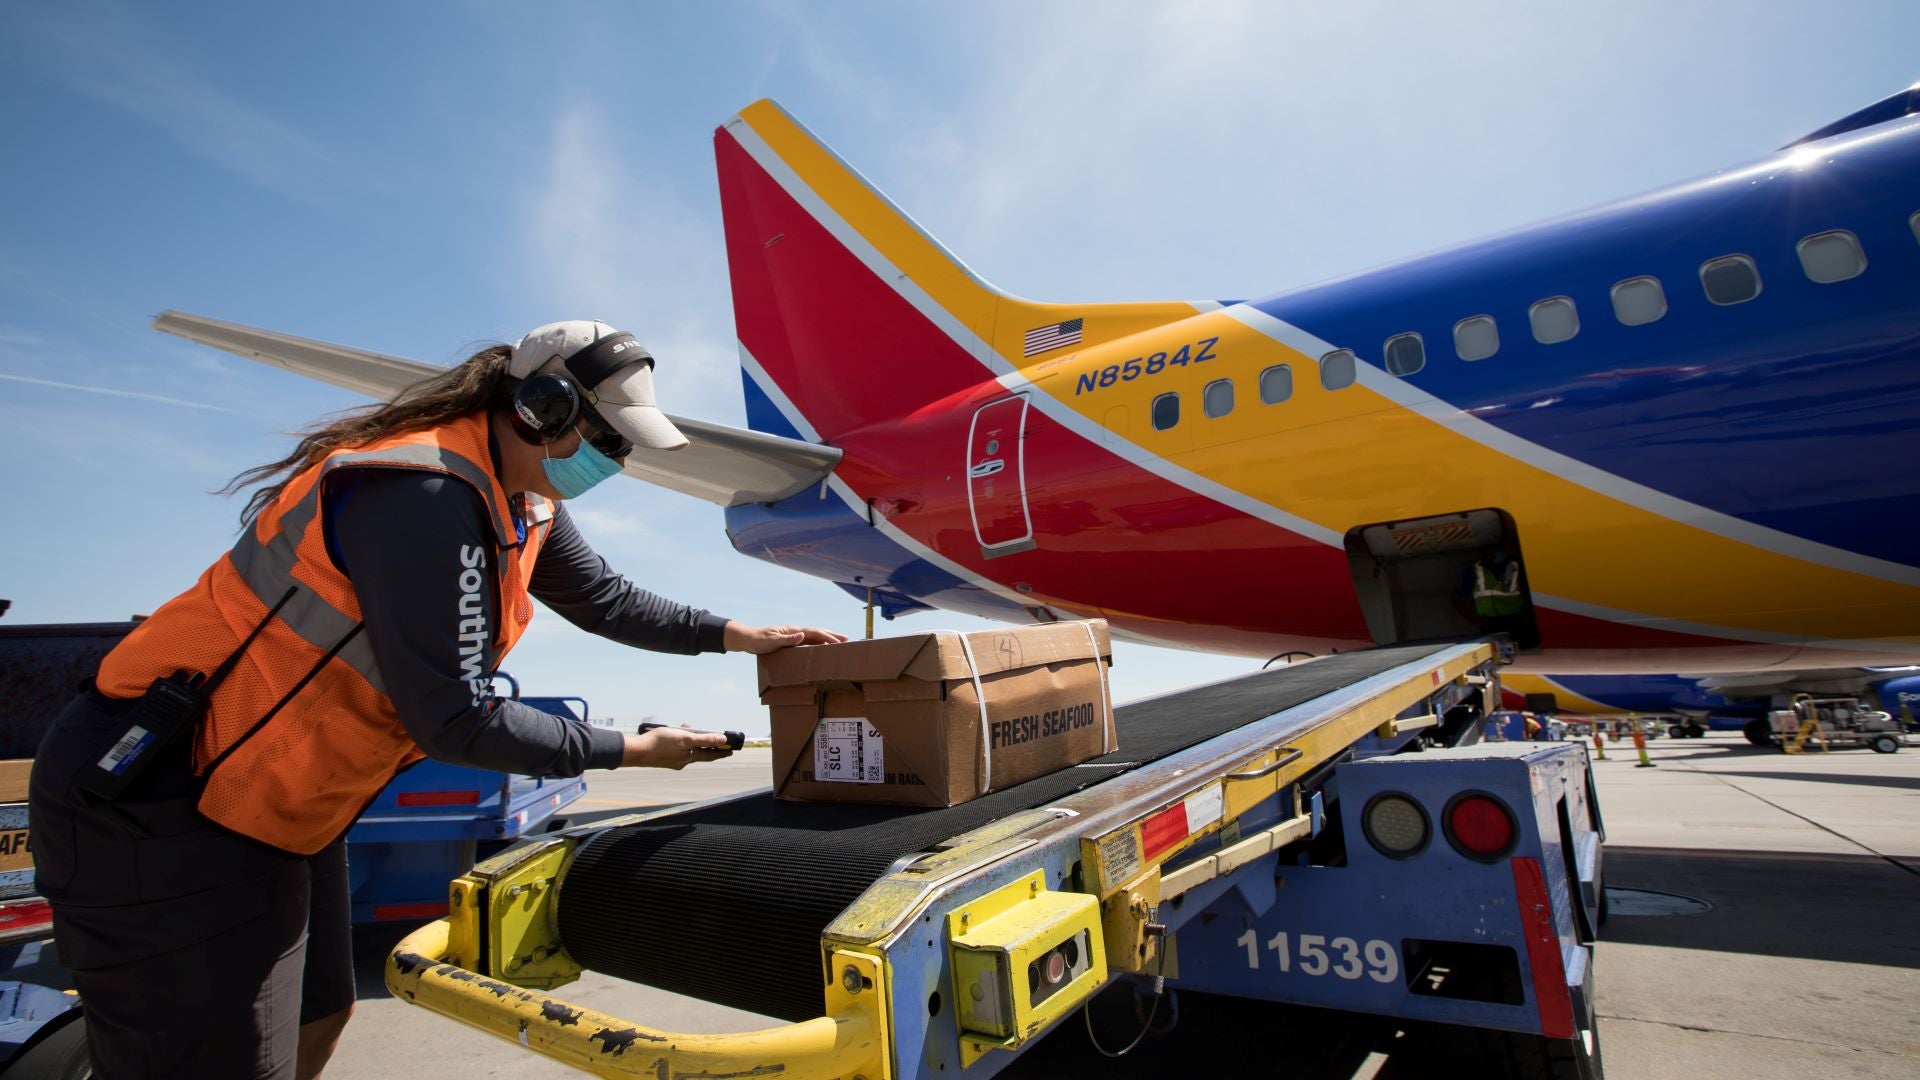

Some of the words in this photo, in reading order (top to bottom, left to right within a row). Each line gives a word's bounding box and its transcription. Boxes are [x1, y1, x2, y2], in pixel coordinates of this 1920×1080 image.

[1075, 336, 1220, 396] N8584Z
[991, 714, 1039, 749] FRESH
[1042, 702, 1094, 737] SEAFOOD
[829, 747, 841, 771] SLC
[1236, 928, 1400, 983] 11539
